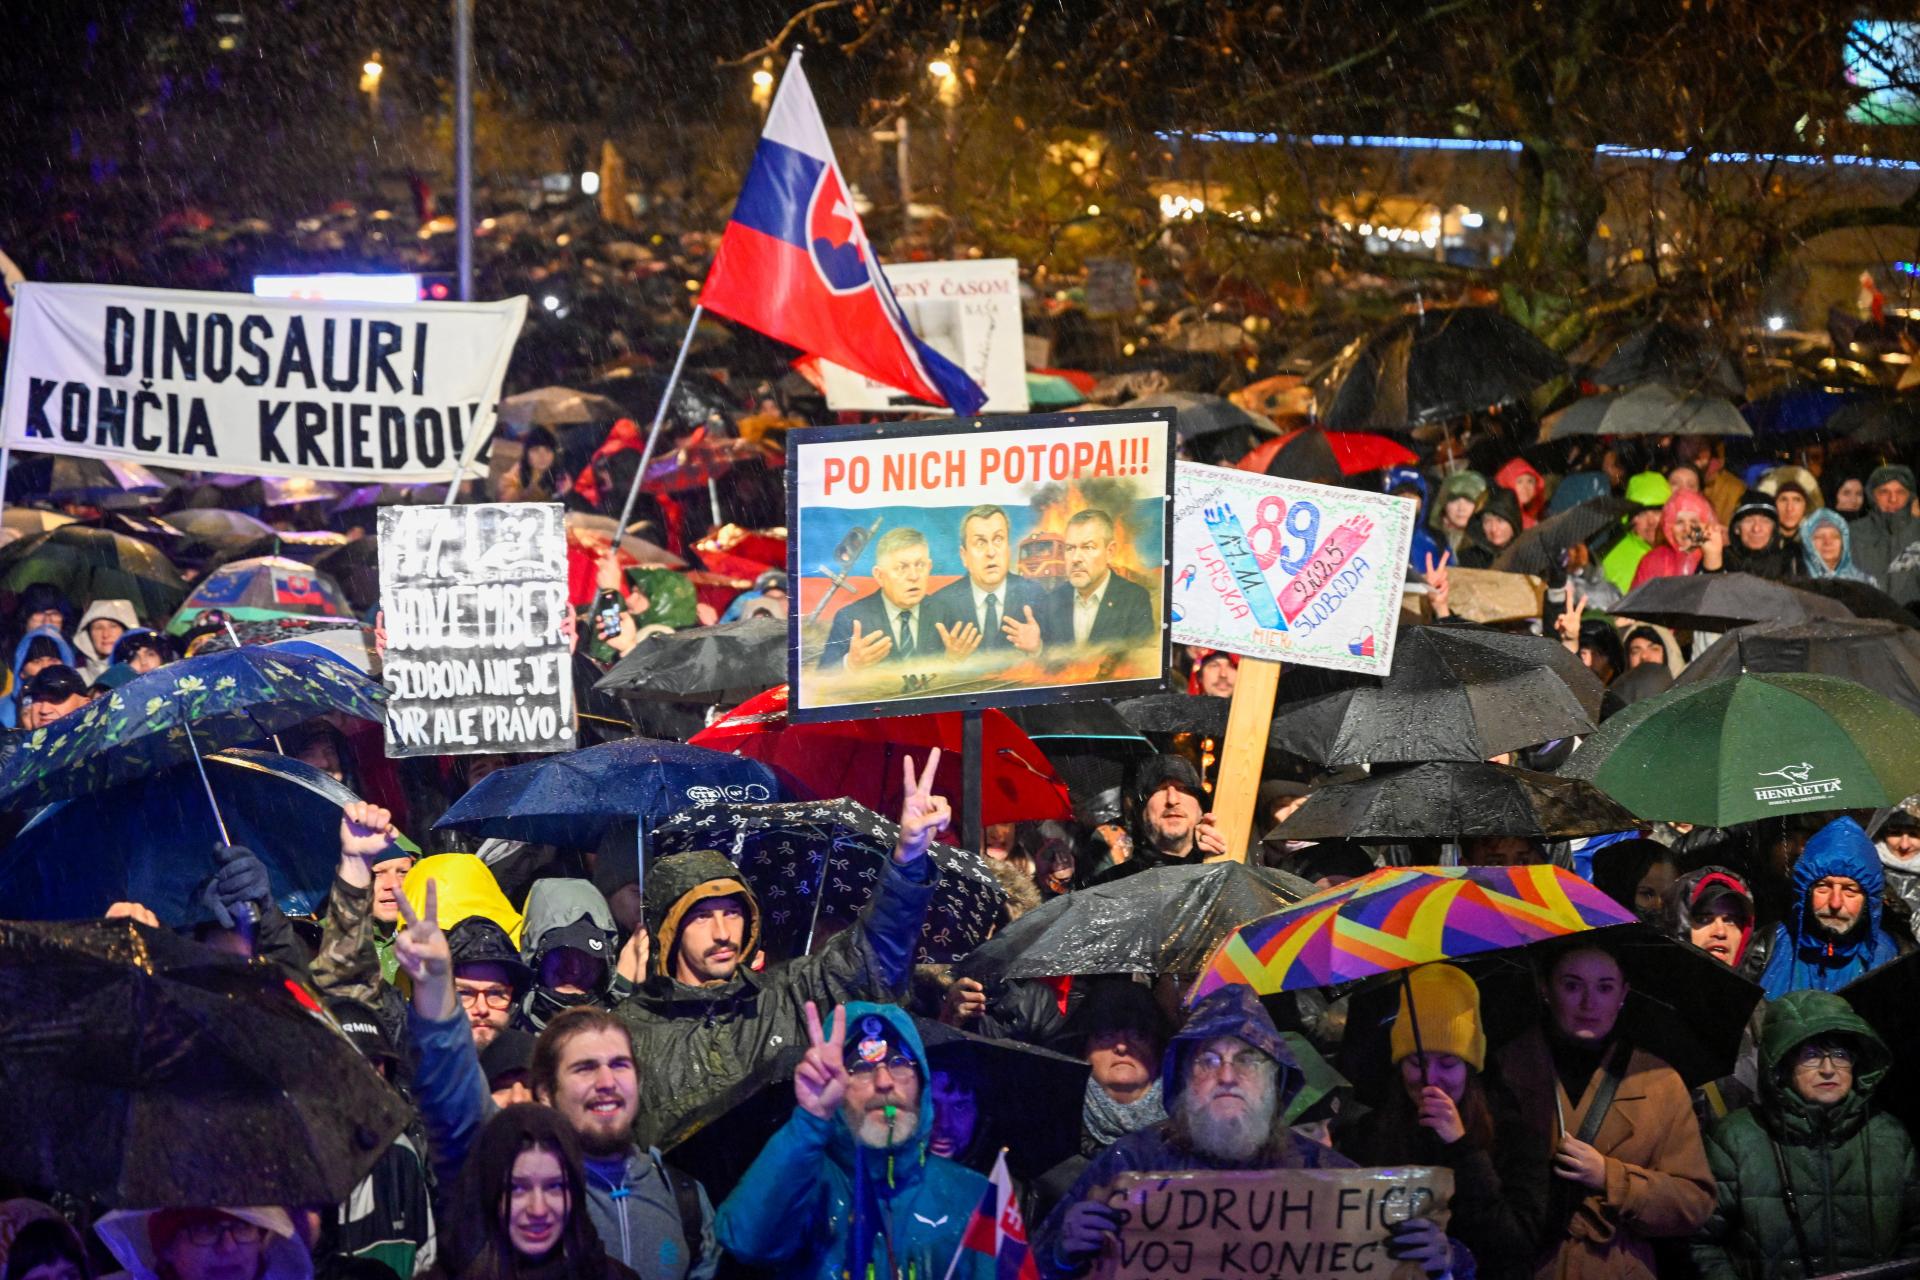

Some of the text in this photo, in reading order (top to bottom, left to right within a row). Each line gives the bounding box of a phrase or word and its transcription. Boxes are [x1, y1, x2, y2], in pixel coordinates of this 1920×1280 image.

[940, 278, 1010, 297] ČASOM
[105, 306, 428, 396] DINOSAURI
[25, 377, 218, 458] KONČIA
[824, 437, 1150, 496] PO NICH POTOPA!!!
[1247, 495, 1320, 577] 89
[385, 581, 570, 650] NOVEMBER
[1294, 556, 1371, 638] SLOBODA
[384, 654, 558, 700] SLOBODA NIE JE
[434, 707, 479, 745] ALE
[1755, 782, 1842, 800] HENRIETTA
[1106, 1178, 1313, 1232] SÚDRUH
[1219, 1239, 1378, 1275] KONIEC
